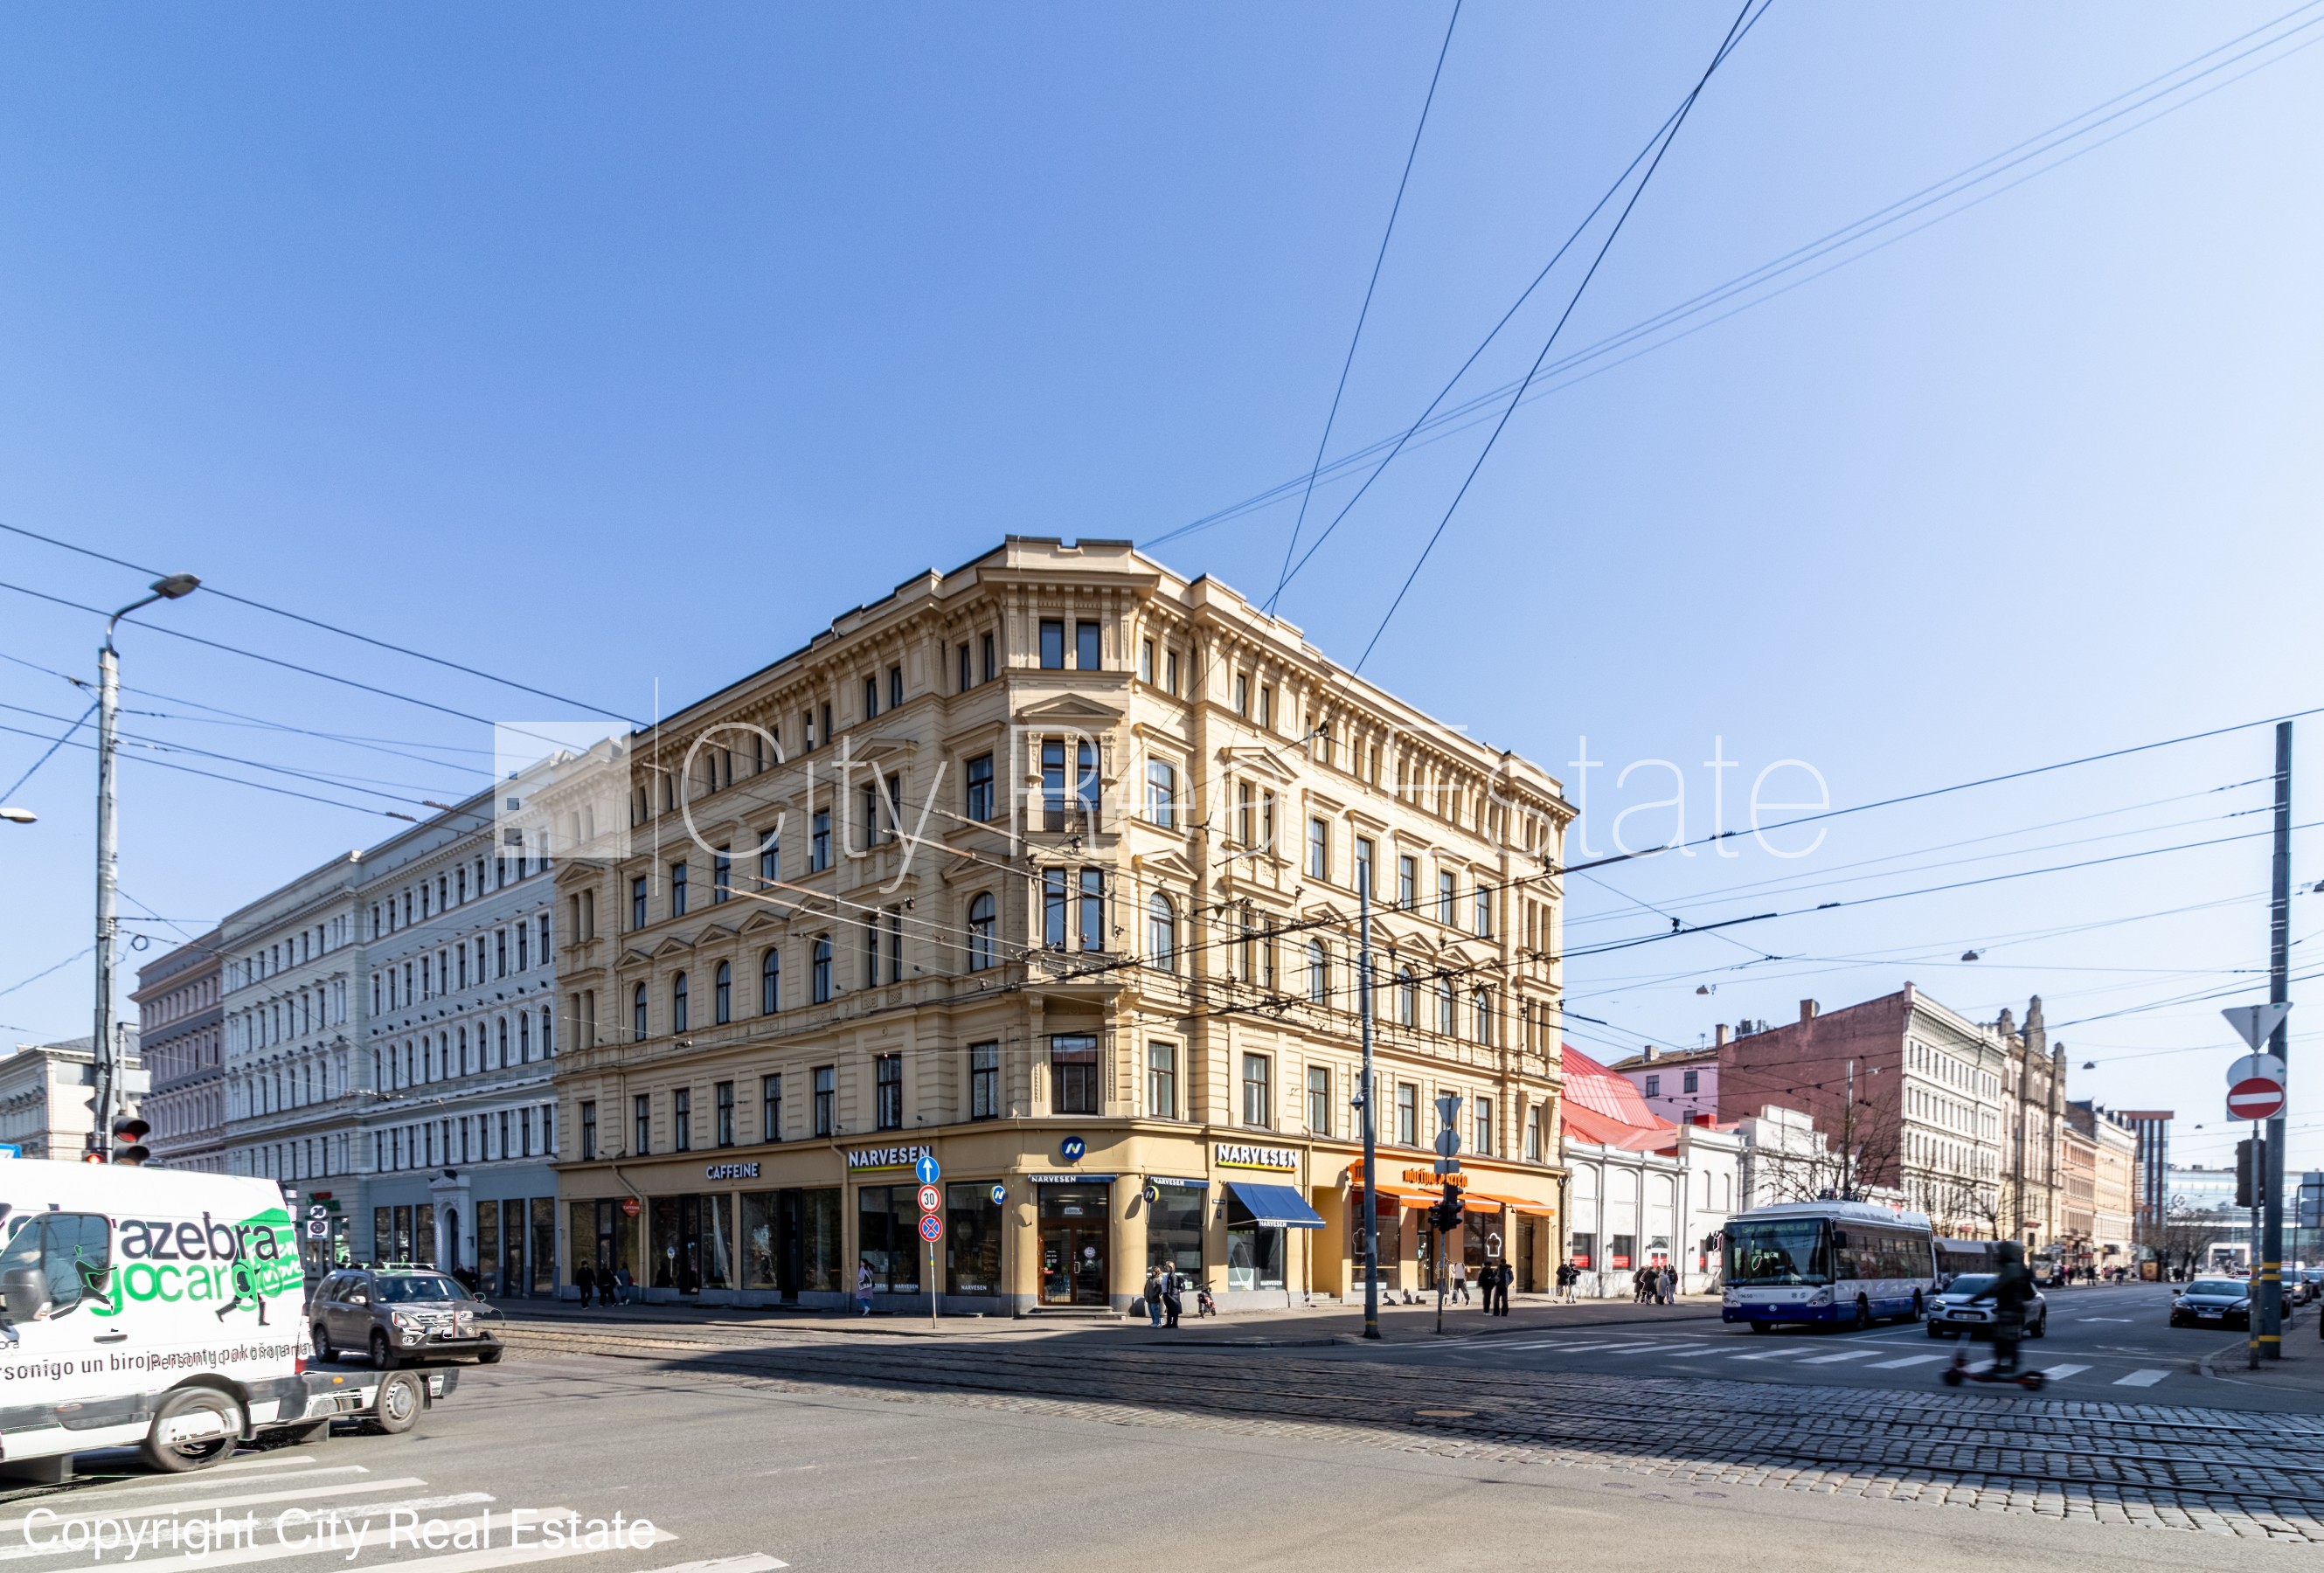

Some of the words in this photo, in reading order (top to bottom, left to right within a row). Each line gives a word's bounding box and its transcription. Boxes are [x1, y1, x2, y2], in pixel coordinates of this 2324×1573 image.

[849, 1146, 930, 1168] NARVESEN
[1217, 1143, 1299, 1168] NARVESEN
[705, 1162, 760, 1180] CAFFEINE
[1153, 1177, 1185, 1187] NARVESEN
[923, 1193, 935, 1206] 30
[81, 1359, 103, 1374] un
